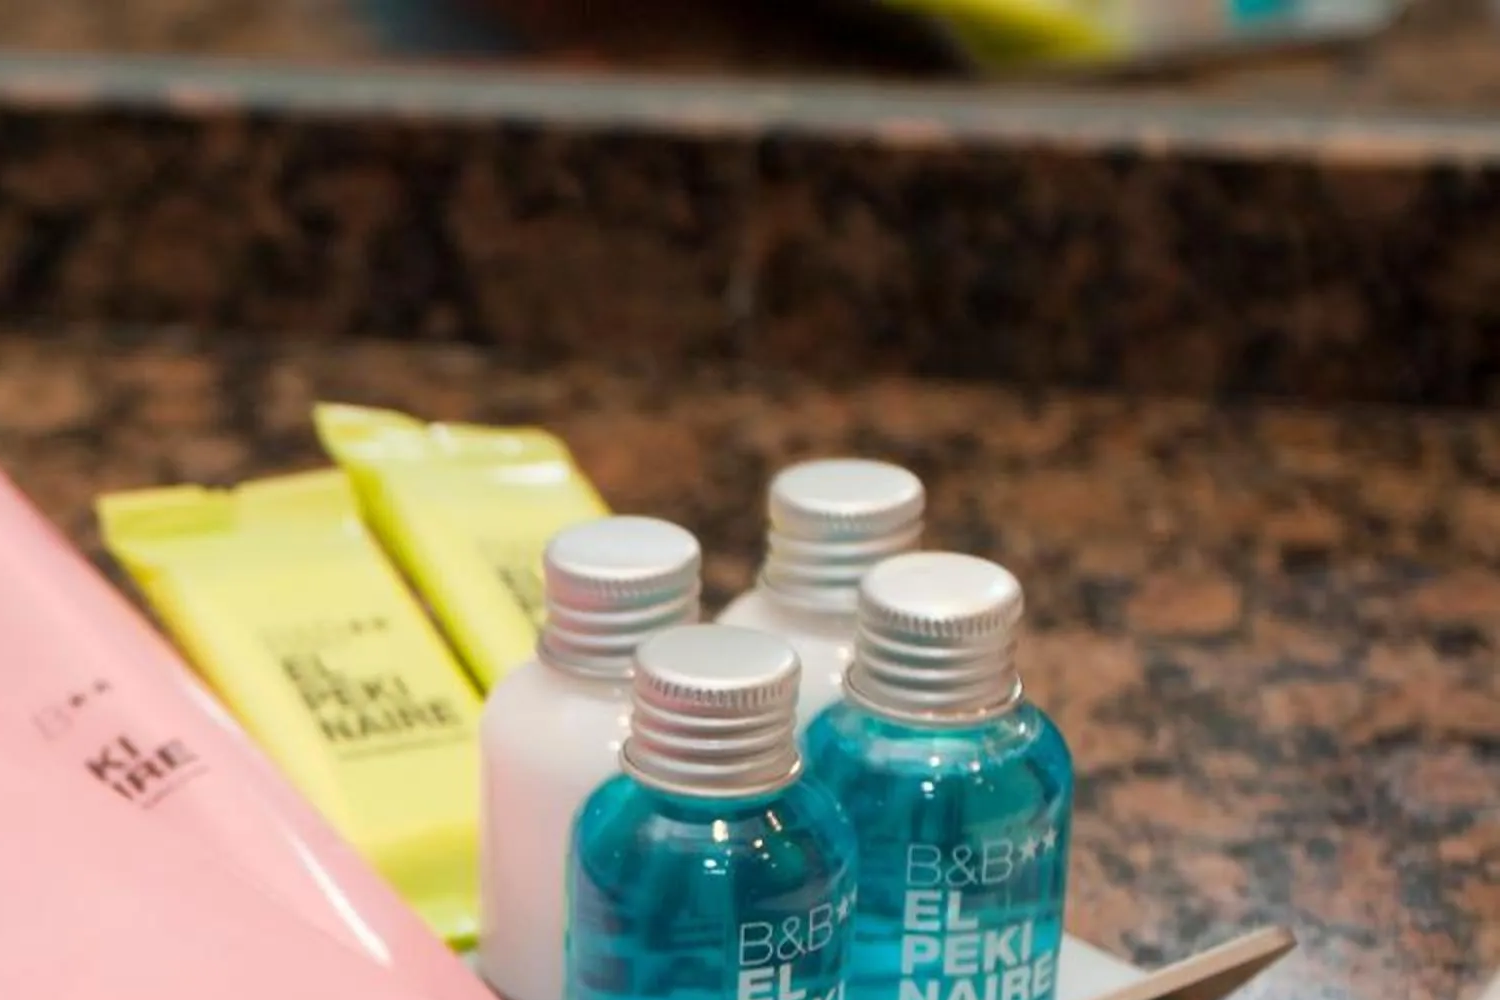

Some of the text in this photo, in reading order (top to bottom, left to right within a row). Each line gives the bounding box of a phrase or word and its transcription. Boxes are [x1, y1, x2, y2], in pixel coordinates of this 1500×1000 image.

[83, 735, 141, 781] KI
[111, 738, 201, 801] IRE
[905, 838, 1014, 887] B&B
[738, 902, 834, 967] B&B
[903, 888, 980, 932] EL
[900, 919, 1034, 977] PEKI
